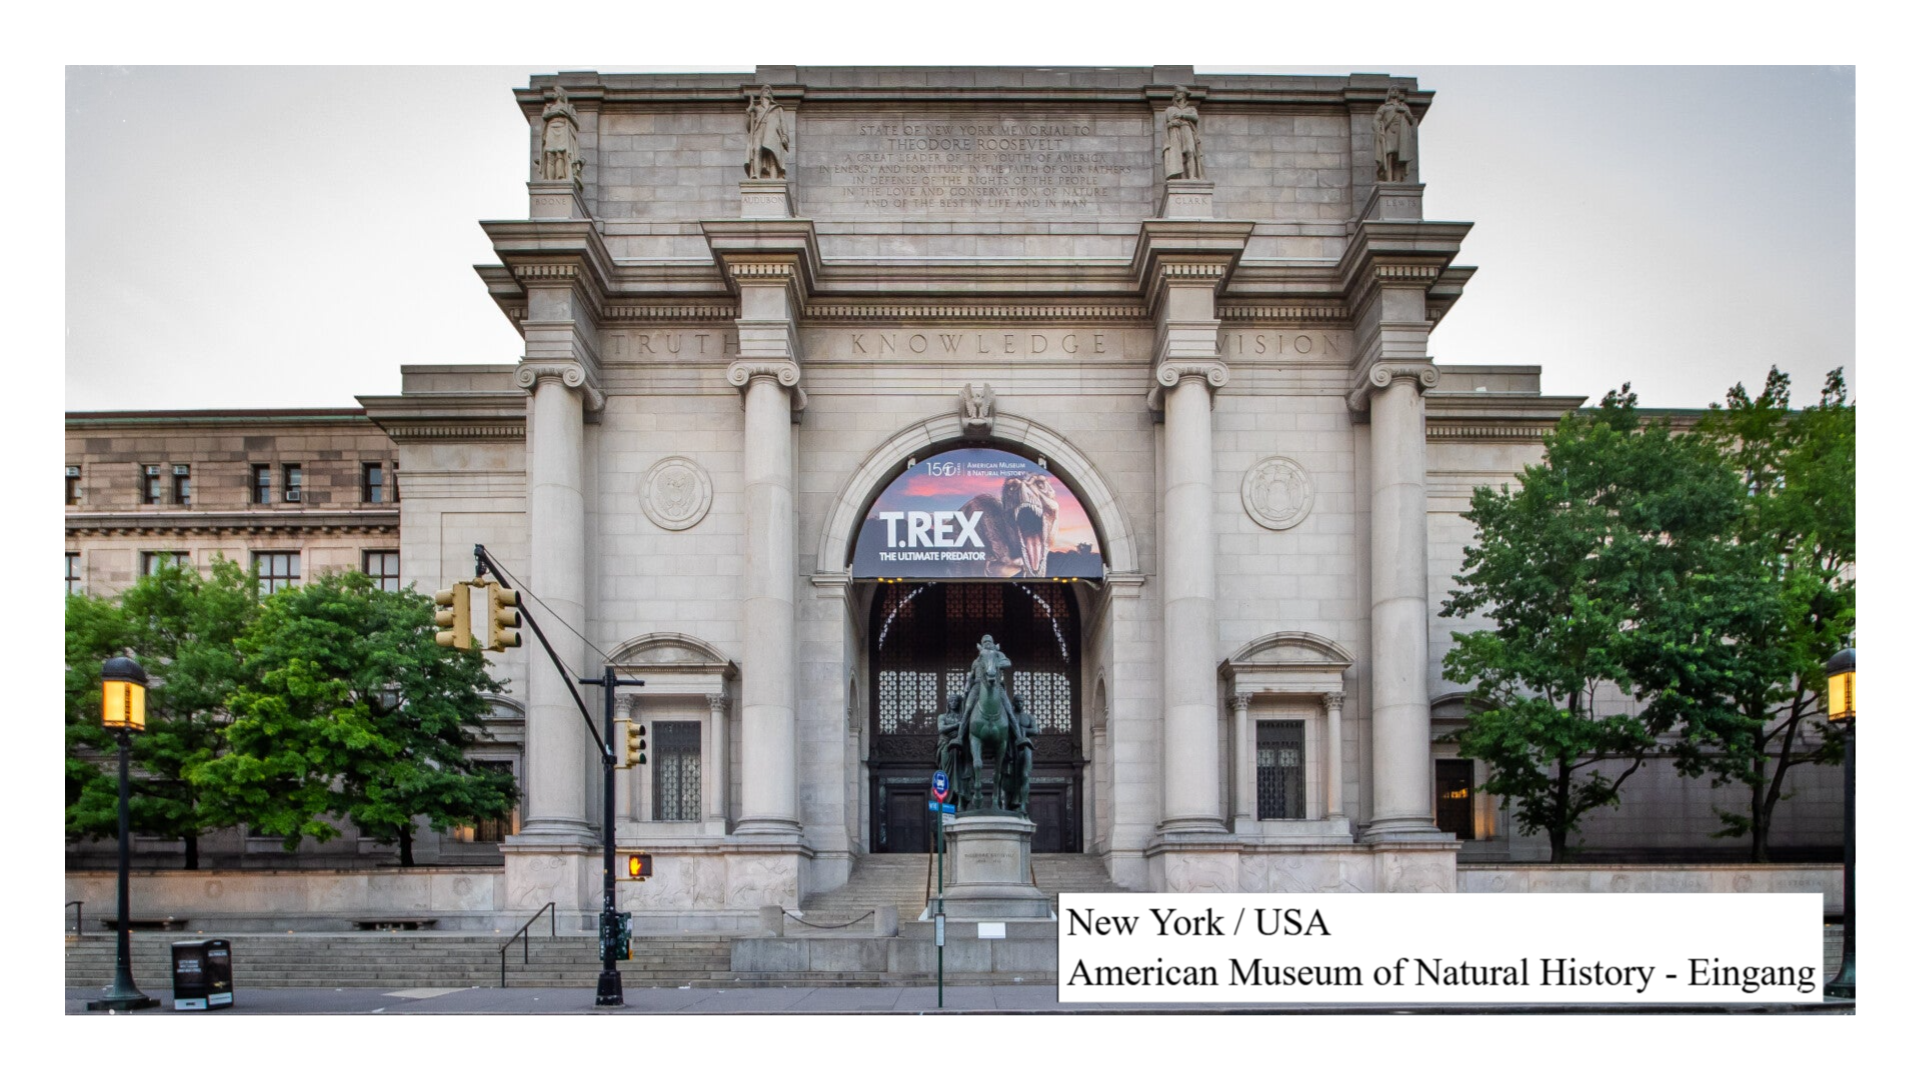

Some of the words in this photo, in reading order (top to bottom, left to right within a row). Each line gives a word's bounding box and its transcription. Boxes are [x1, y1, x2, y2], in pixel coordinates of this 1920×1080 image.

[860, 126, 898, 136] STATE
[904, 126, 920, 136] OF
[926, 126, 954, 136] NEW
[960, 126, 994, 136] YORK
[1001, 126, 1069, 136] MEMORIAL
[1074, 126, 1090, 136] TO
[887, 139, 970, 150] THEODORE
[977, 139, 1063, 150] ROOSEVELT
[845, 154, 852, 162] A
[857, 154, 894, 162] GREAT
[900, 154, 940, 162] LEADER
[946, 154, 961, 162] OF
[967, 154, 987, 162] THE
[994, 154, 1031, 162] YOUTH
[1037, 154, 1051, 162] OF
[1057, 154, 1106, 162] AMERICA
[820, 165, 830, 174] IN
[834, 165, 875, 174] ENERGY
[879, 165, 900, 174] AND
[906, 165, 964, 174] FORTITUDE
[970, 165, 980, 174] IN
[985, 165, 1003, 174] THE
[1009, 165, 1038, 174] FAITH
[1043, 165, 1056, 174] OF
[1060, 165, 1084, 174] OUR
[1088, 165, 1131, 174] FATHERS
[852, 176, 864, 185] IN
[871, 176, 917, 185] DEFENSE
[922, 176, 936, 185] OF
[942, 176, 961, 185] THE
[968, 176, 1008, 185] RIGHTS
[1014, 176, 1027, 185] OF
[1032, 176, 1052, 185] THE
[1059, 176, 1097, 185] PEOPLE
[843, 188, 854, 196] IN
[861, 188, 880, 196] THE
[886, 188, 915, 196] LOVE
[921, 188, 944, 196] AND
[950, 188, 1036, 196] CONSERVATION
[1043, 188, 1057, 196] OF
[1063, 188, 1108, 196] NATURE
[744, 196, 784, 204] AUDUBON
[864, 200, 888, 208] AND
[894, 200, 907, 208] OF
[914, 200, 934, 208] THE
[940, 200, 964, 208] BEST
[970, 200, 981, 208] IN
[989, 200, 1010, 208] LIFE
[1017, 200, 1039, 208] AND
[1046, 200, 1056, 208] IN
[1063, 200, 1086, 208] MAN
[610, 334, 740, 354] TRUTH
[852, 334, 1106, 354] KNOWLEDGE
[1216, 334, 1340, 354] VISION
[879, 511, 985, 548] T.REX
[879, 552, 897, 561] THE
[898, 552, 939, 561] ULTIMATE
[941, 552, 985, 561] PREDATOR
